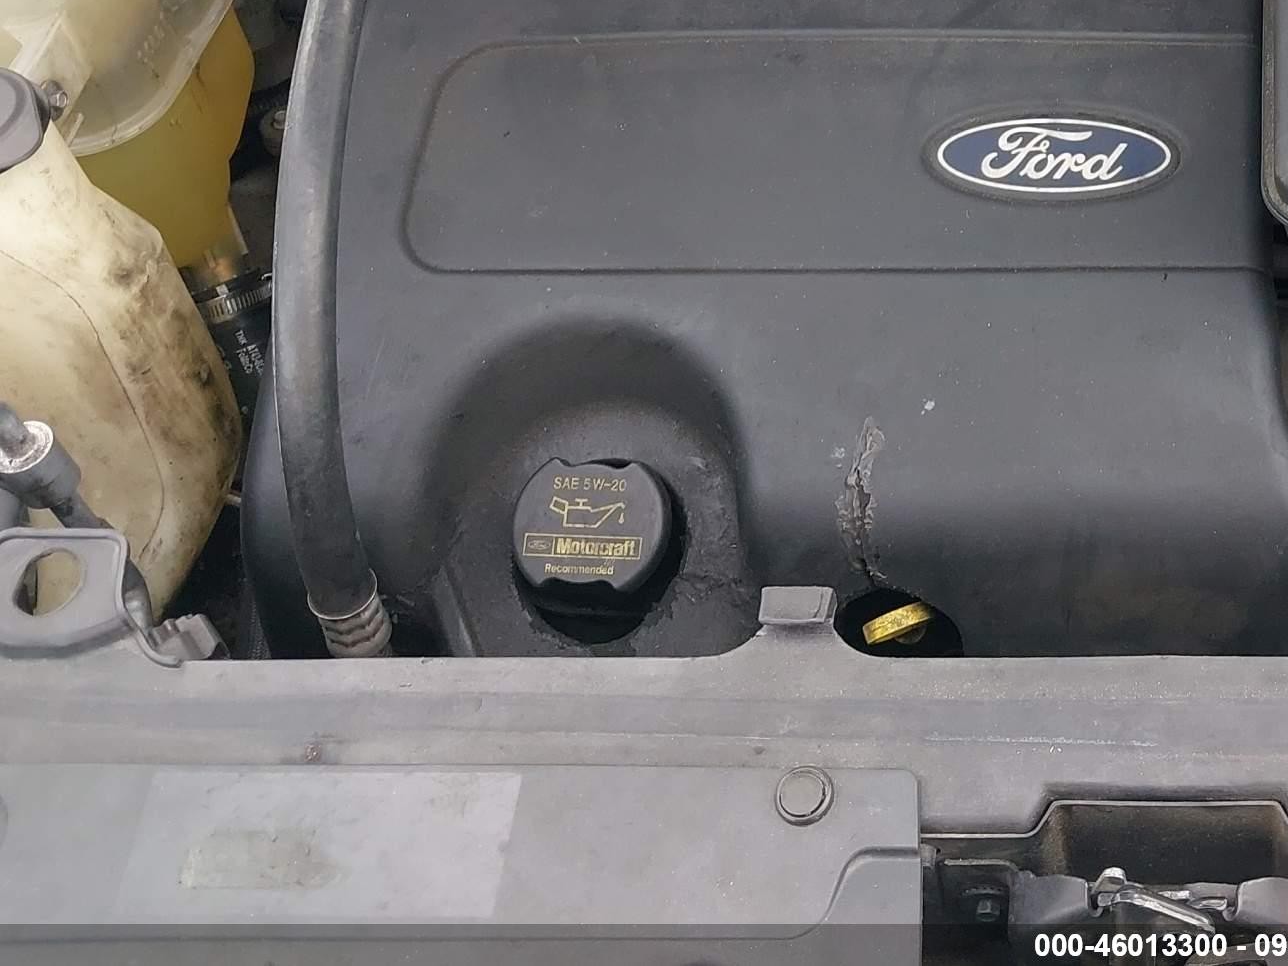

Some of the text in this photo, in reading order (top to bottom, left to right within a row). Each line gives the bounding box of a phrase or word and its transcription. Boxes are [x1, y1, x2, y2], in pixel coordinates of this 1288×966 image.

[981, 126, 1128, 181] Ford
[554, 477, 627, 492] SAE 5W-20
[556, 537, 635, 556] Motorcraft
[544, 563, 614, 575] Recommended
